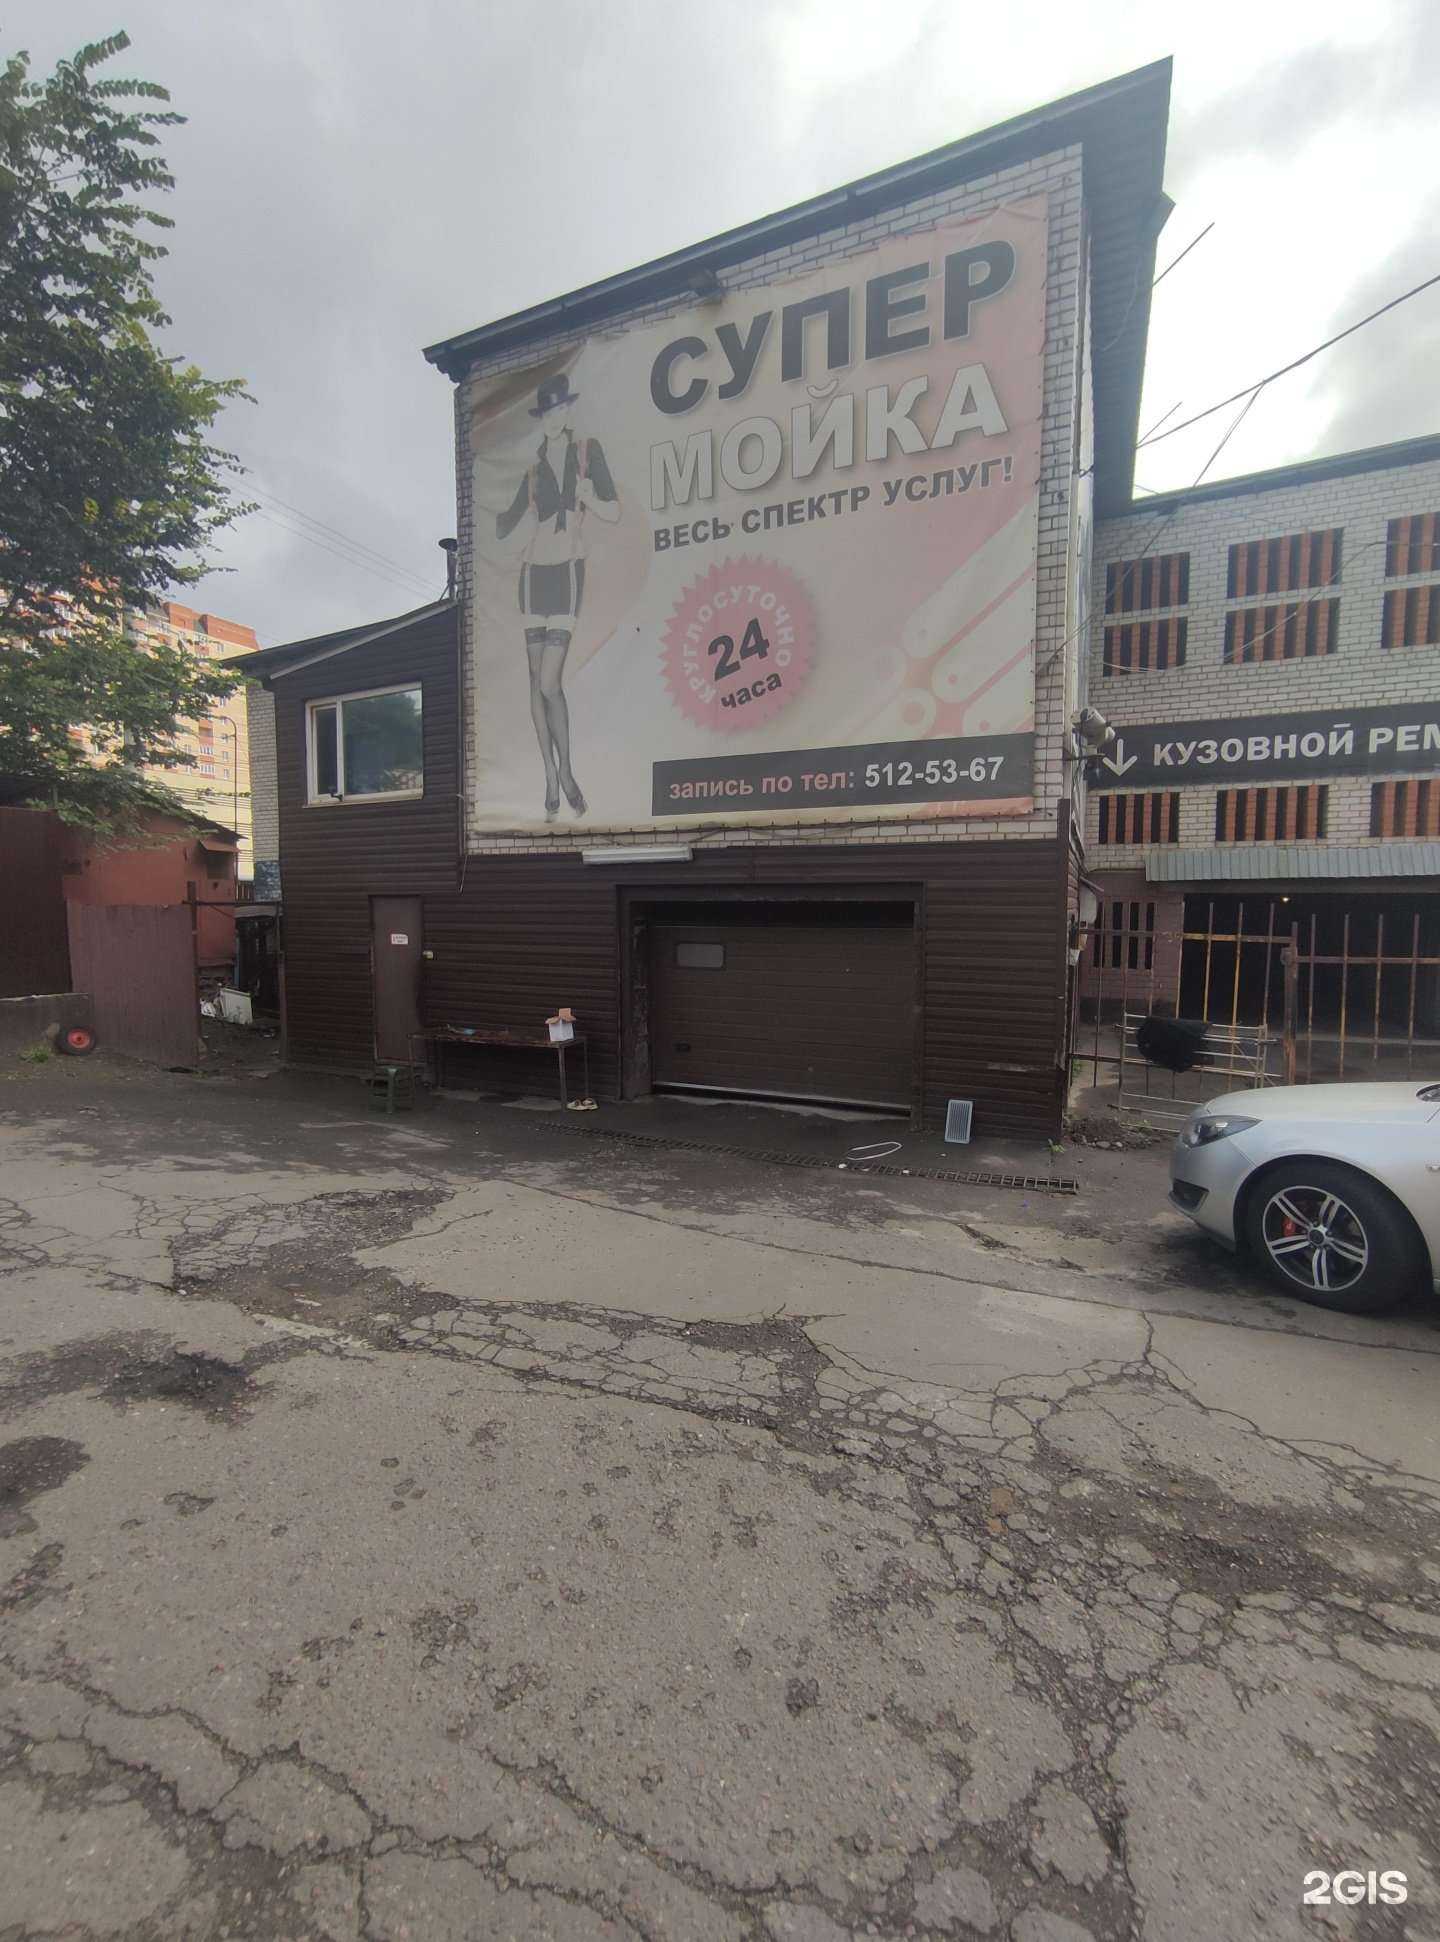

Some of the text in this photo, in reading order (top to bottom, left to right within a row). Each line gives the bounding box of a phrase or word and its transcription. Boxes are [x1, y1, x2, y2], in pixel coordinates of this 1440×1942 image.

[649, 239, 1017, 415] СУПЕР
[650, 362, 1010, 511] МОЙКА
[654, 456, 1014, 552] ВЕСЬ СПЕКТР УСЛУГ!
[707, 618, 770, 682] 24
[720, 673, 783, 709] часа
[1153, 722, 1354, 766] КУЗОВНОЙ
[669, 756, 1005, 800] запись по тел: 512-53-67
